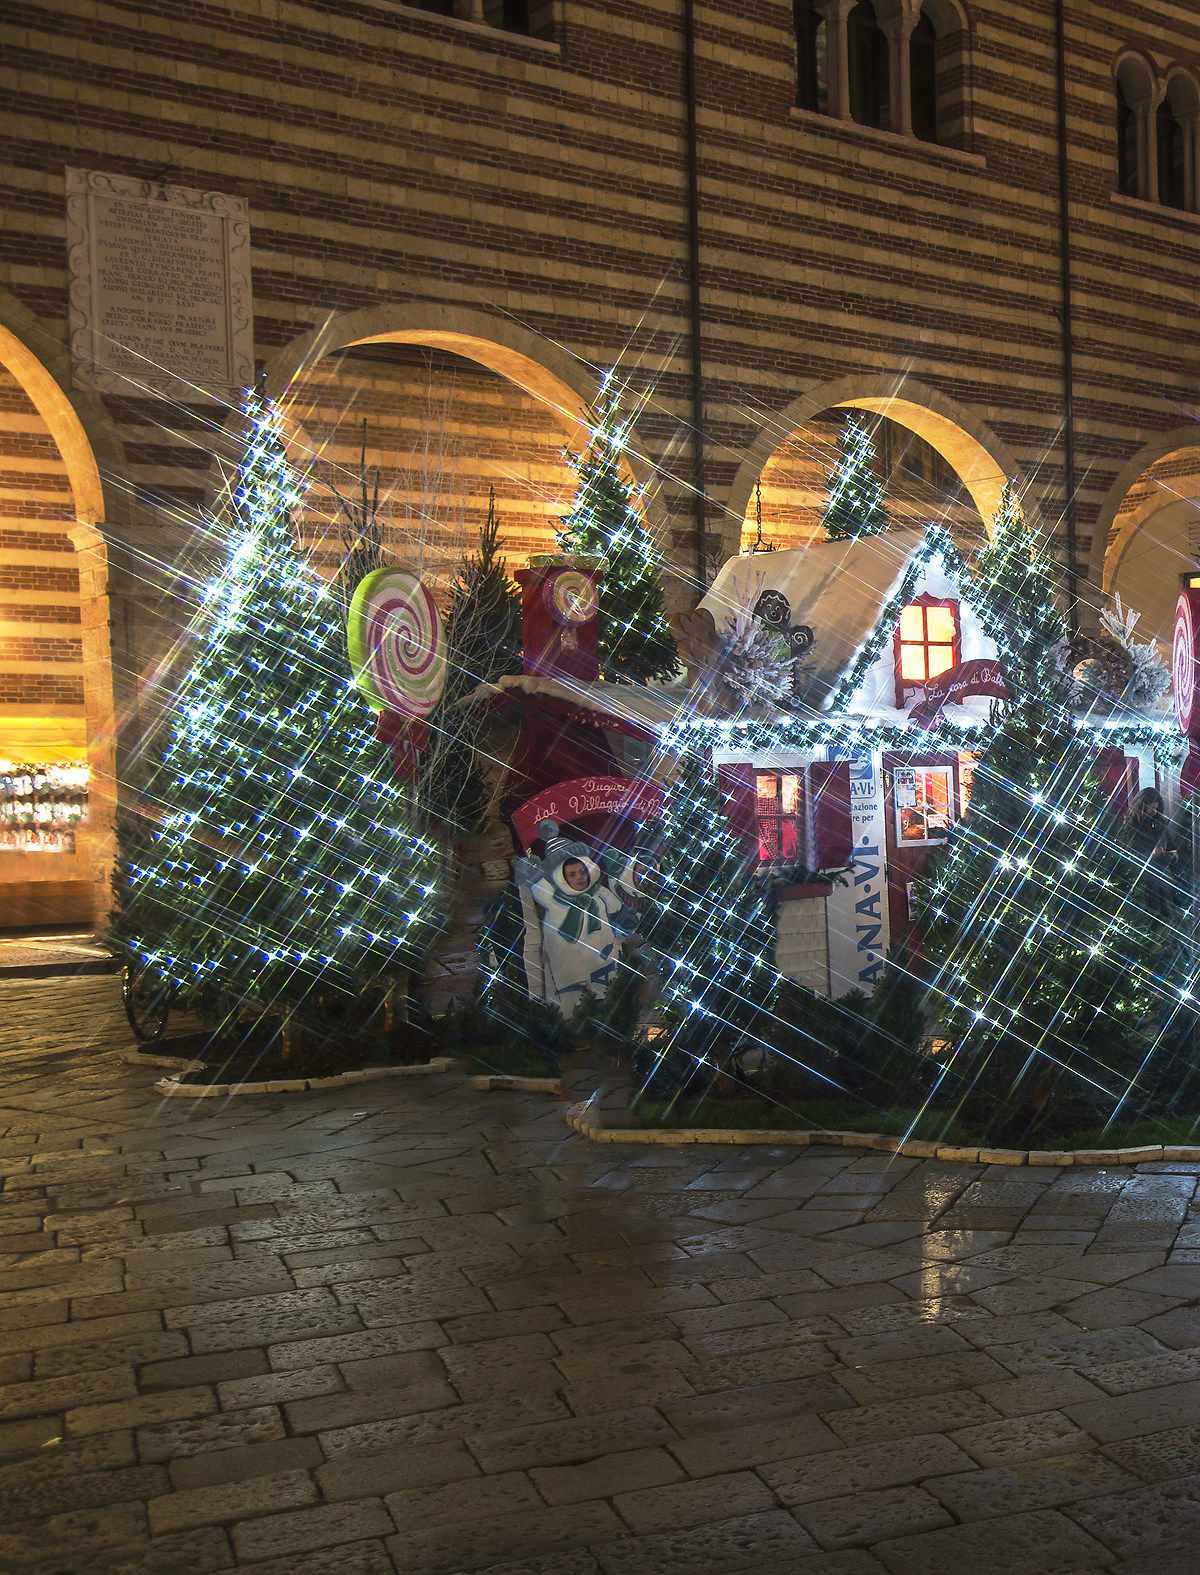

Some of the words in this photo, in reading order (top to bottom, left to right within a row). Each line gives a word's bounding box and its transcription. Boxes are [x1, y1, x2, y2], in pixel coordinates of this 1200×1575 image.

[970, 672, 980, 684] di
[533, 802, 559, 825] dal
[569, 794, 629, 814] Villaggio
[862, 815, 874, 823] per
